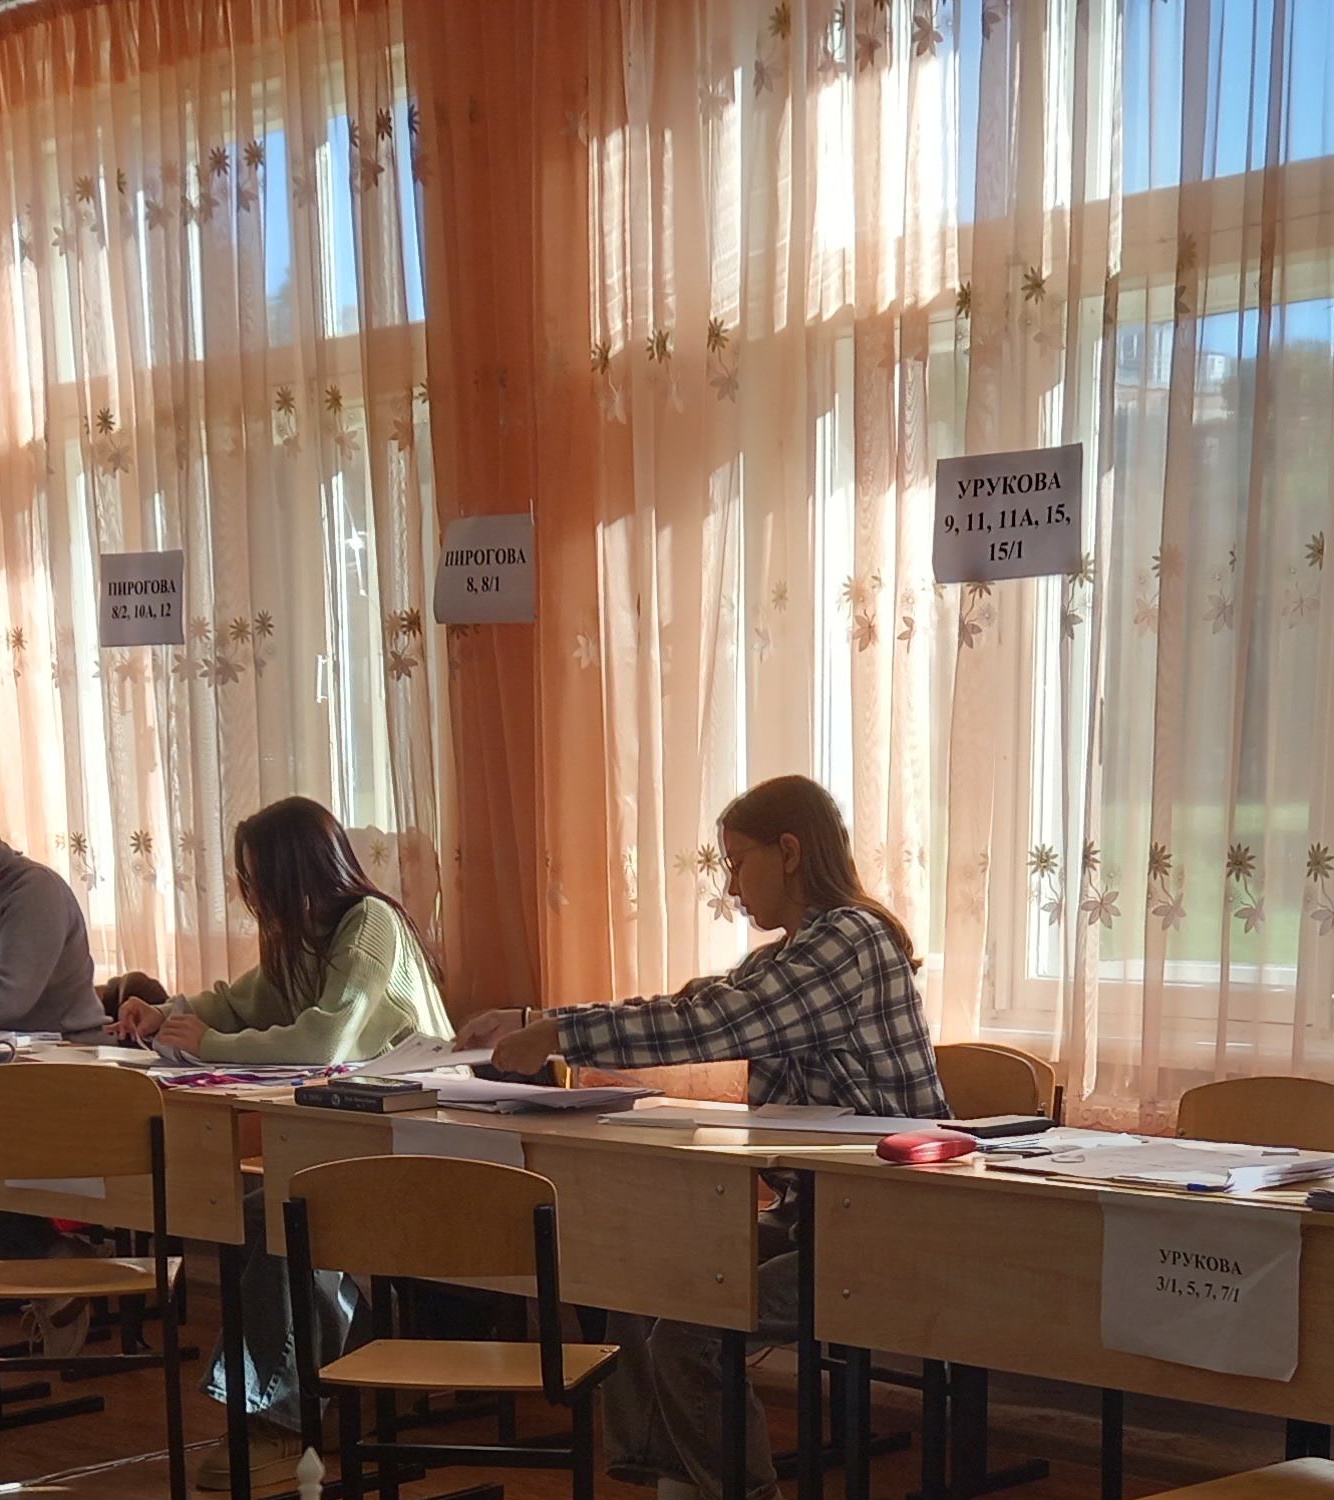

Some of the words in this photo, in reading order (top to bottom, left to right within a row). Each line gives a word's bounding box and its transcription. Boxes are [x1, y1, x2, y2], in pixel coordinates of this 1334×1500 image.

[957, 471, 1061, 499] УРУКОВА
[944, 514, 960, 536] 9,
[966, 512, 992, 534] 11,
[999, 508, 1039, 529] 11А,
[1046, 503, 1071, 525] 15,
[445, 547, 527, 567] ПИРОГОВА
[989, 540, 1023, 561] 15/1
[108, 579, 176, 596] ПИРОГОВА
[467, 576, 478, 594] 8,
[481, 575, 499, 592] 8/1
[111, 604, 131, 620] 8/2,
[134, 604, 157, 620] 10А,
[160, 602, 172, 617] 12
[1159, 1248, 1243, 1276] УРУКОВА
[1156, 1276, 1183, 1296] 3/1,
[1187, 1281, 1200, 1298] 5,
[1204, 1283, 1217, 1300] 7,
[1221, 1286, 1240, 1303] 7/1
